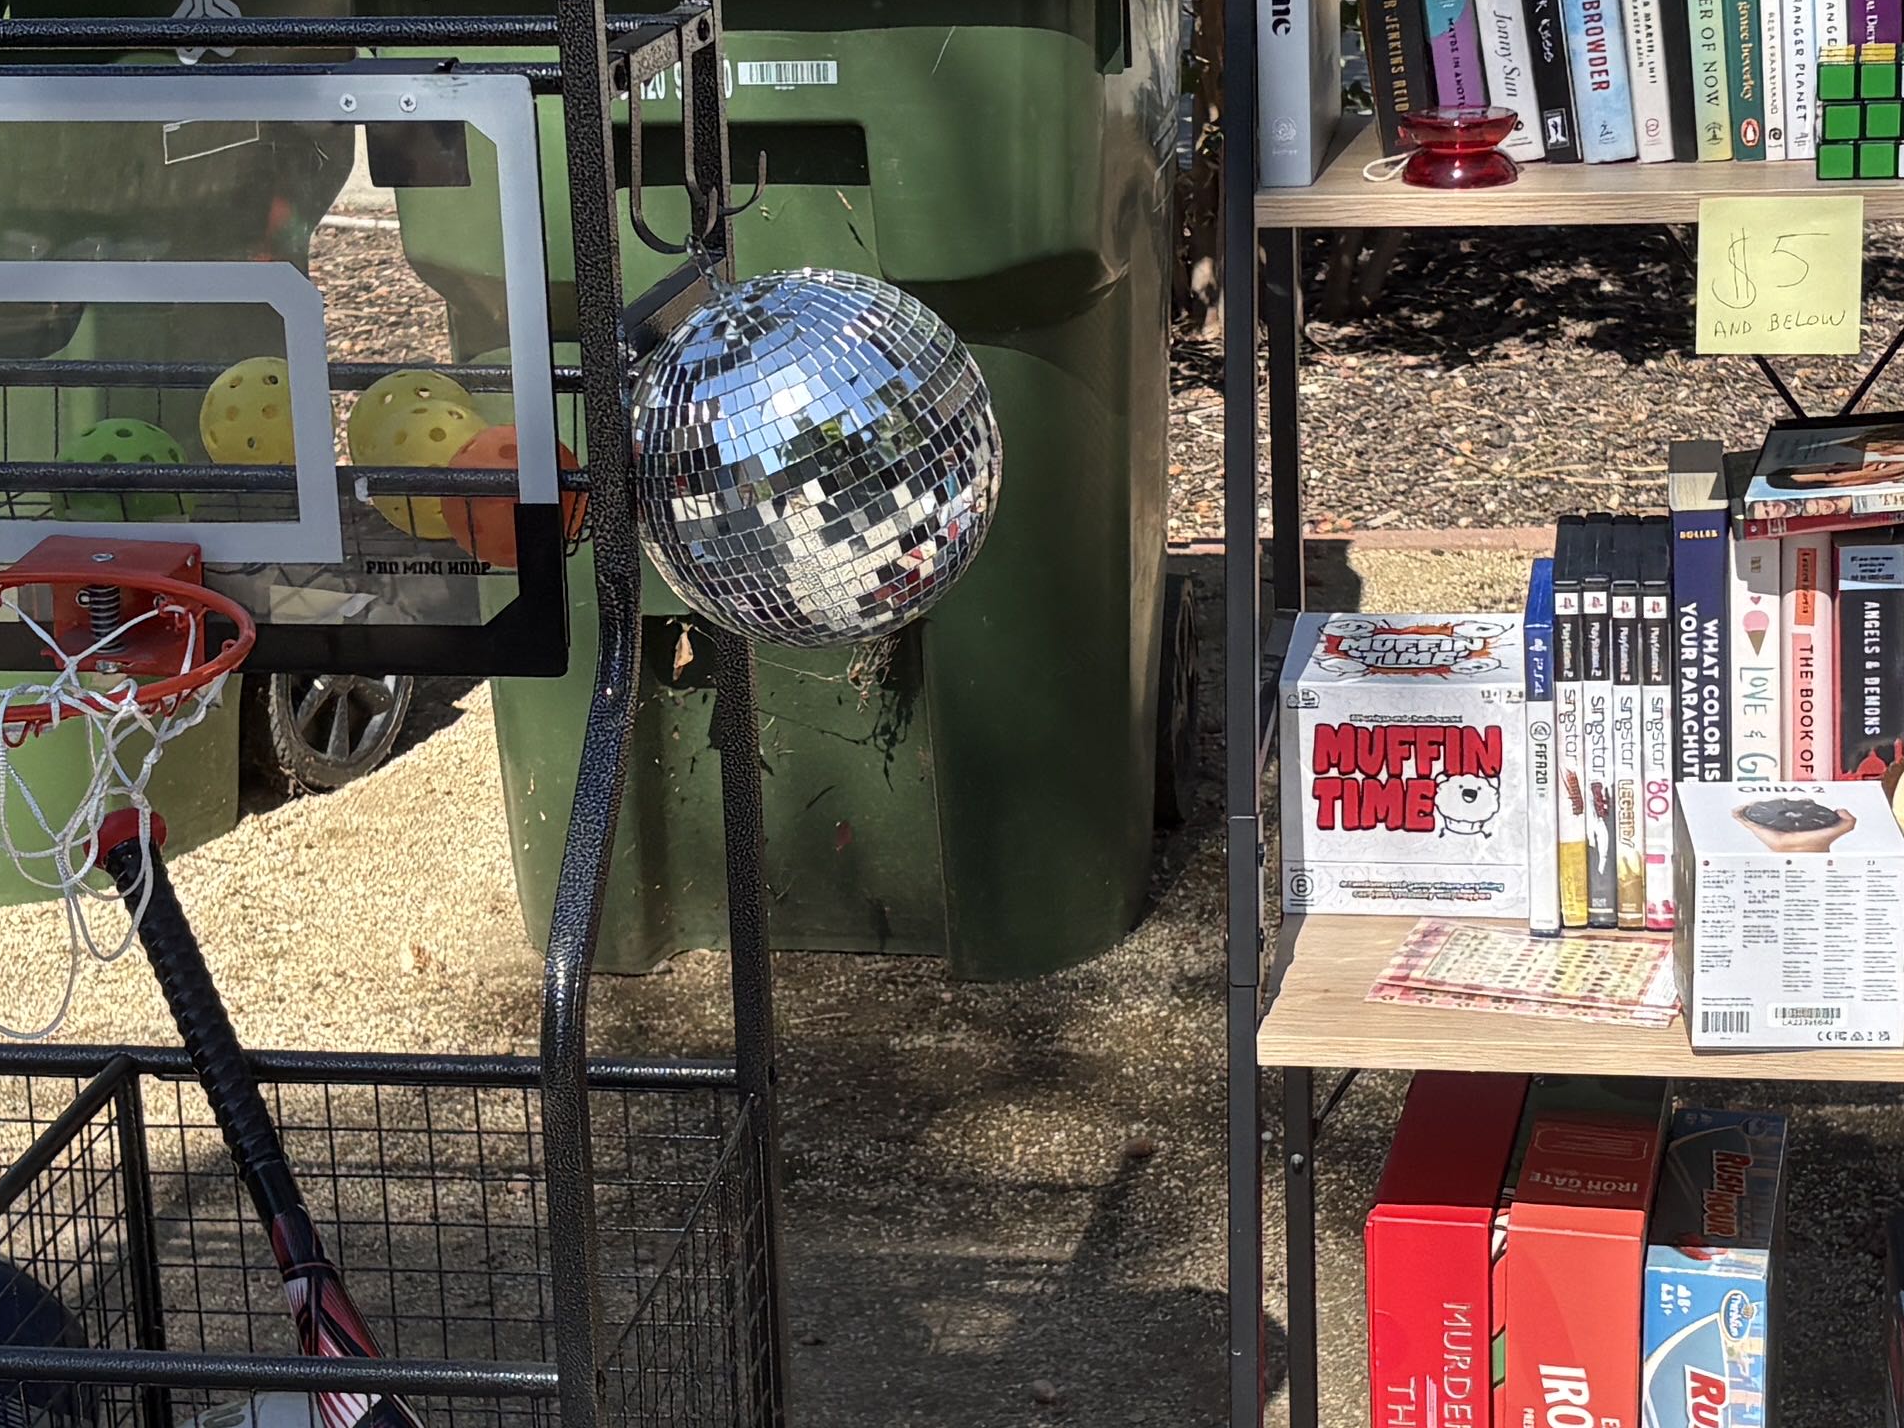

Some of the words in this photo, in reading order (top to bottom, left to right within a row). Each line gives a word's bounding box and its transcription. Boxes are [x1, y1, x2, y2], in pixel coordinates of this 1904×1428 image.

[1385, 13, 1405, 75] JENKINS
[1493, 10, 1512, 63] Jonny
[1503, 65, 1520, 98] Sun
[1582, 0, 1611, 92] BROWDER
[1701, 26, 1716, 52] OF
[1392, 80, 1410, 114] REID
[1703, 60, 1720, 107] NOW
[1795, 64, 1807, 123] PLANET
[1714, 319, 1752, 339] AND
[1767, 310, 1845, 332] BELOW
[448, 561, 491, 576] HOOP
[1338, 638, 1485, 653] MUFFIN
[1680, 602, 1698, 661] YOUR
[1702, 618, 1720, 679] WHAT
[1864, 601, 1880, 654] ANGELS
[1362, 652, 1460, 666] TIME
[1533, 657, 1545, 696] PS4
[1800, 644, 1814, 680] THE
[1739, 667, 1775, 715] LOVE
[1800, 687, 1814, 742] BOOK
[1864, 676, 1881, 735] DEMONS
[1584, 695, 1609, 778] singstar
[1702, 684, 1721, 756] COLOR
[1313, 723, 1503, 779] MUFFIN
[1704, 762, 1721, 782] IS
[1800, 749, 1814, 775] OF
[1312, 776, 1437, 833] TIME
[1713, 1149, 1754, 1196] RUSH
[1702, 1188, 1738, 1237] HOUR
